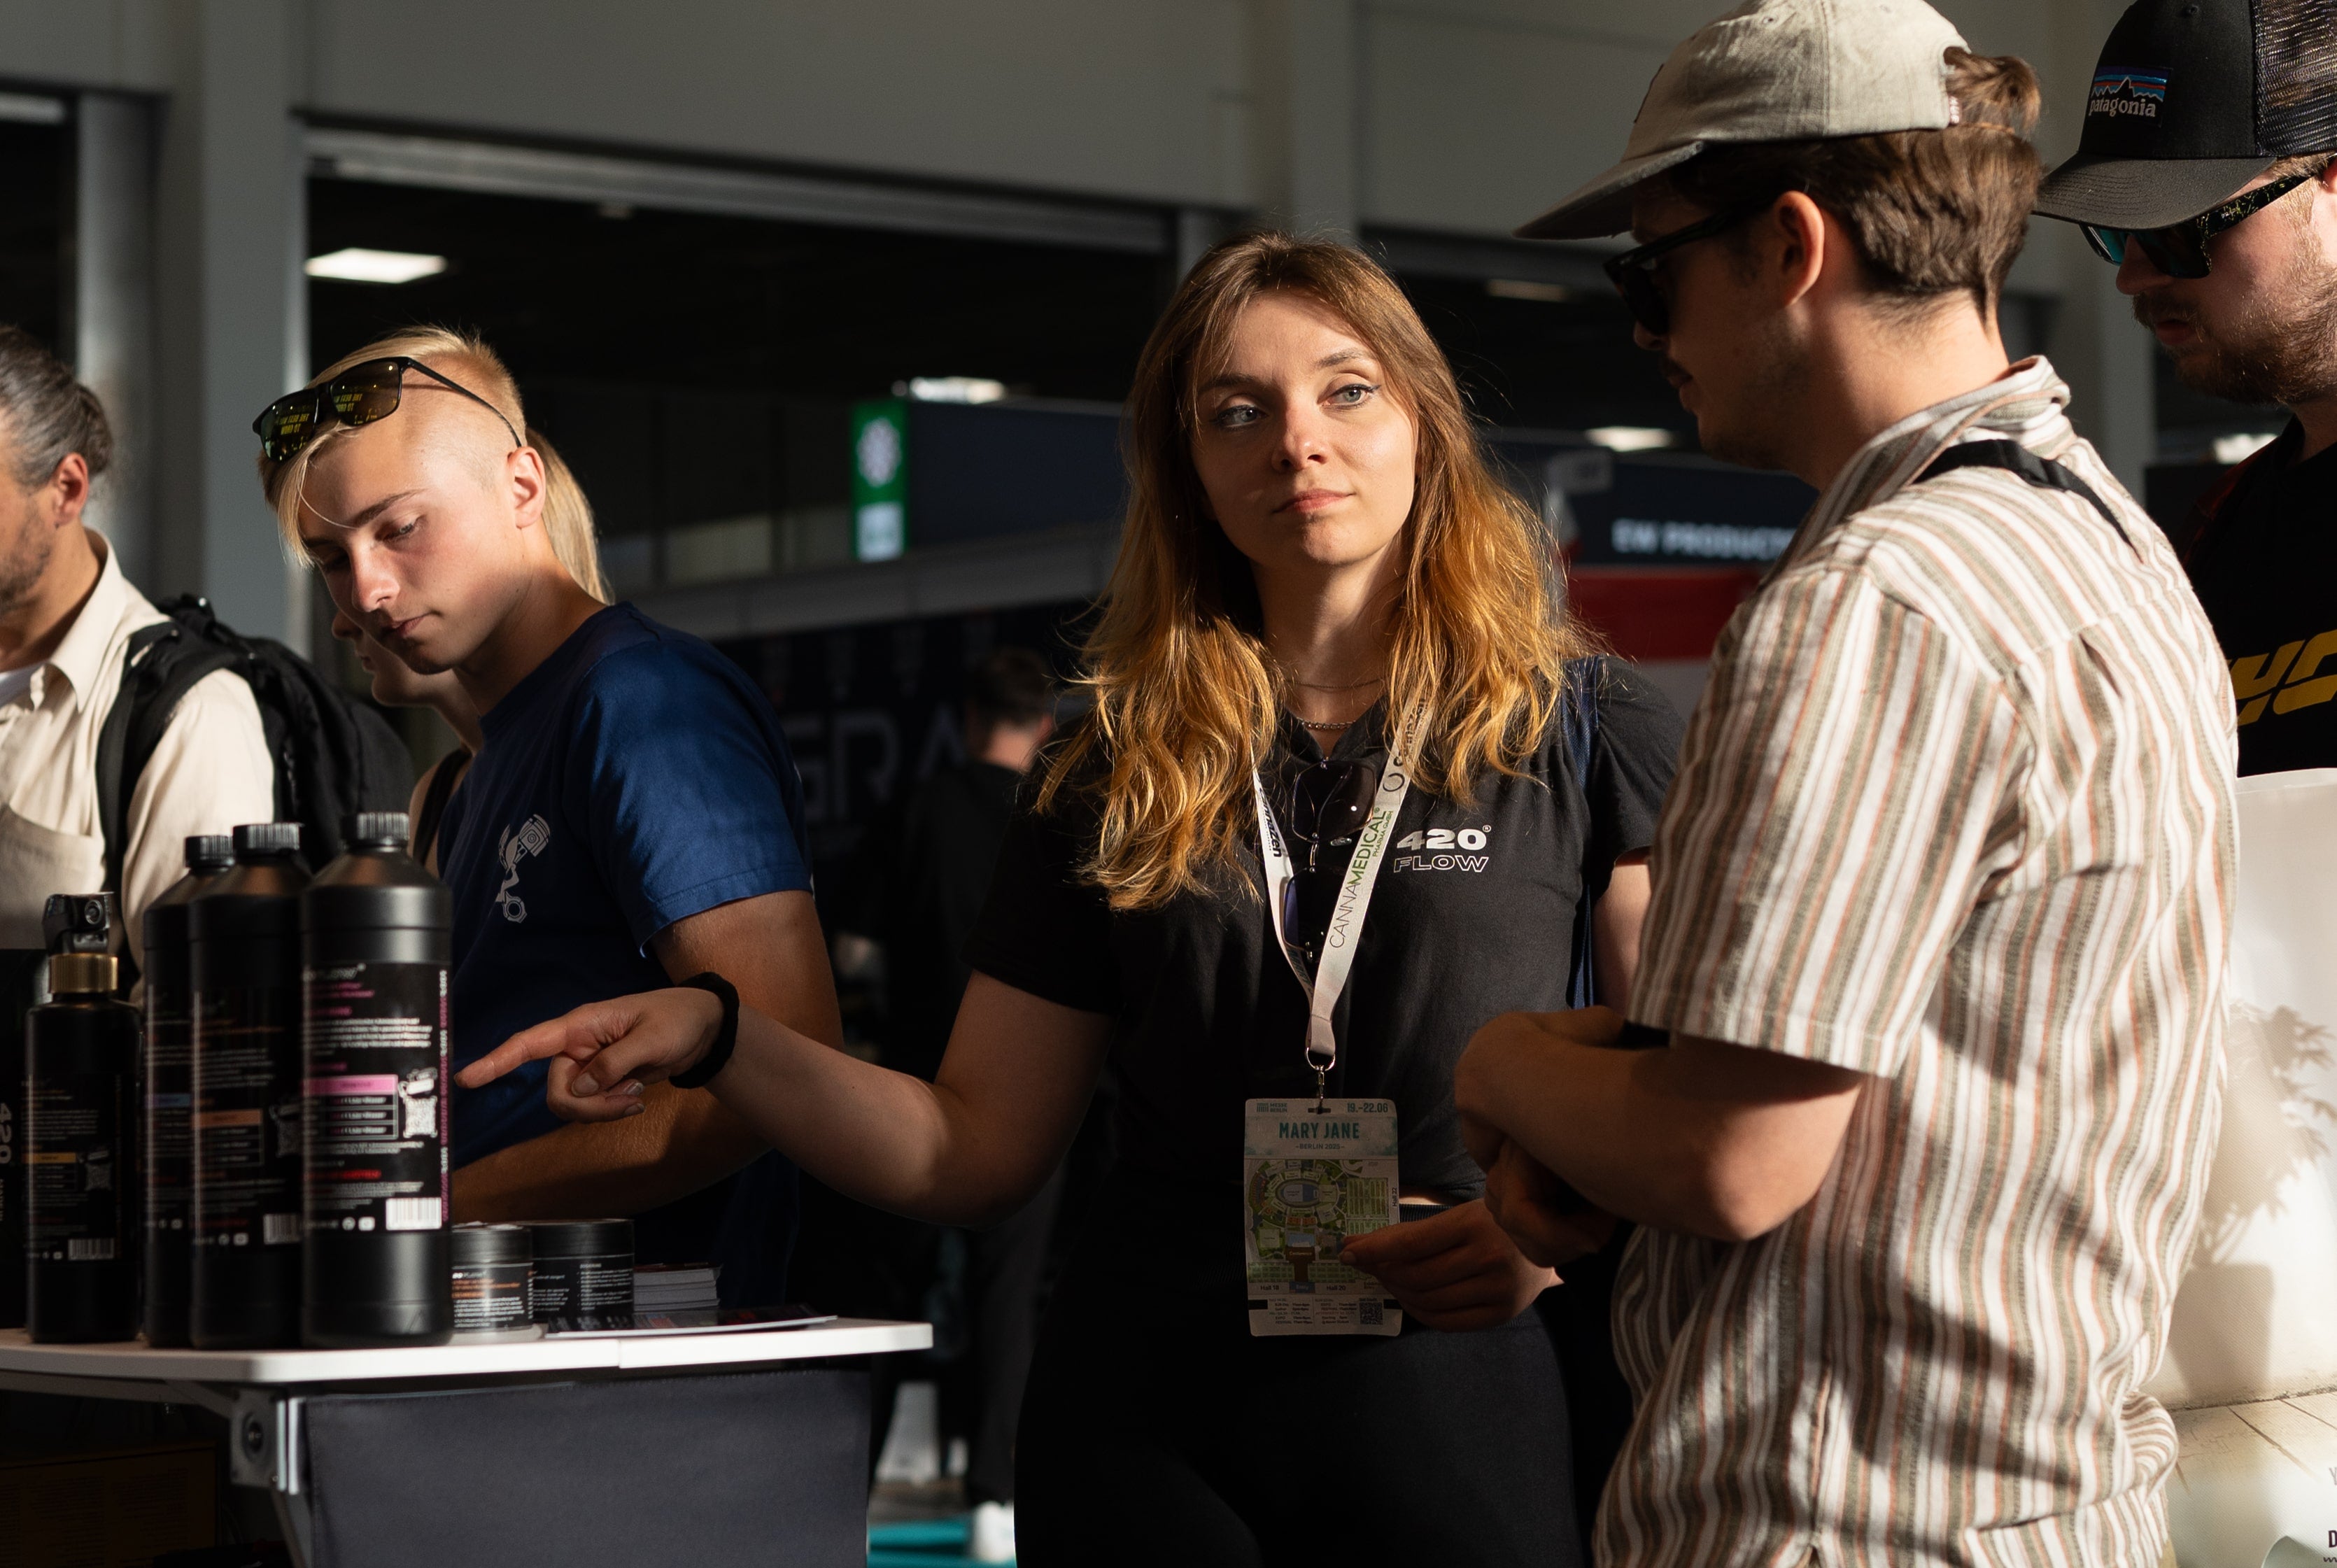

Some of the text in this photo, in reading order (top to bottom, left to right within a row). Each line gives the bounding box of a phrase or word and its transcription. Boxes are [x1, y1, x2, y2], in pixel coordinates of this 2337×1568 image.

[2089, 98, 2156, 117] patagonia
[1372, 830, 1386, 857] PHARMA
[1394, 854, 1489, 873] FLOW
[1278, 1122, 1360, 1139] MARY JANE
